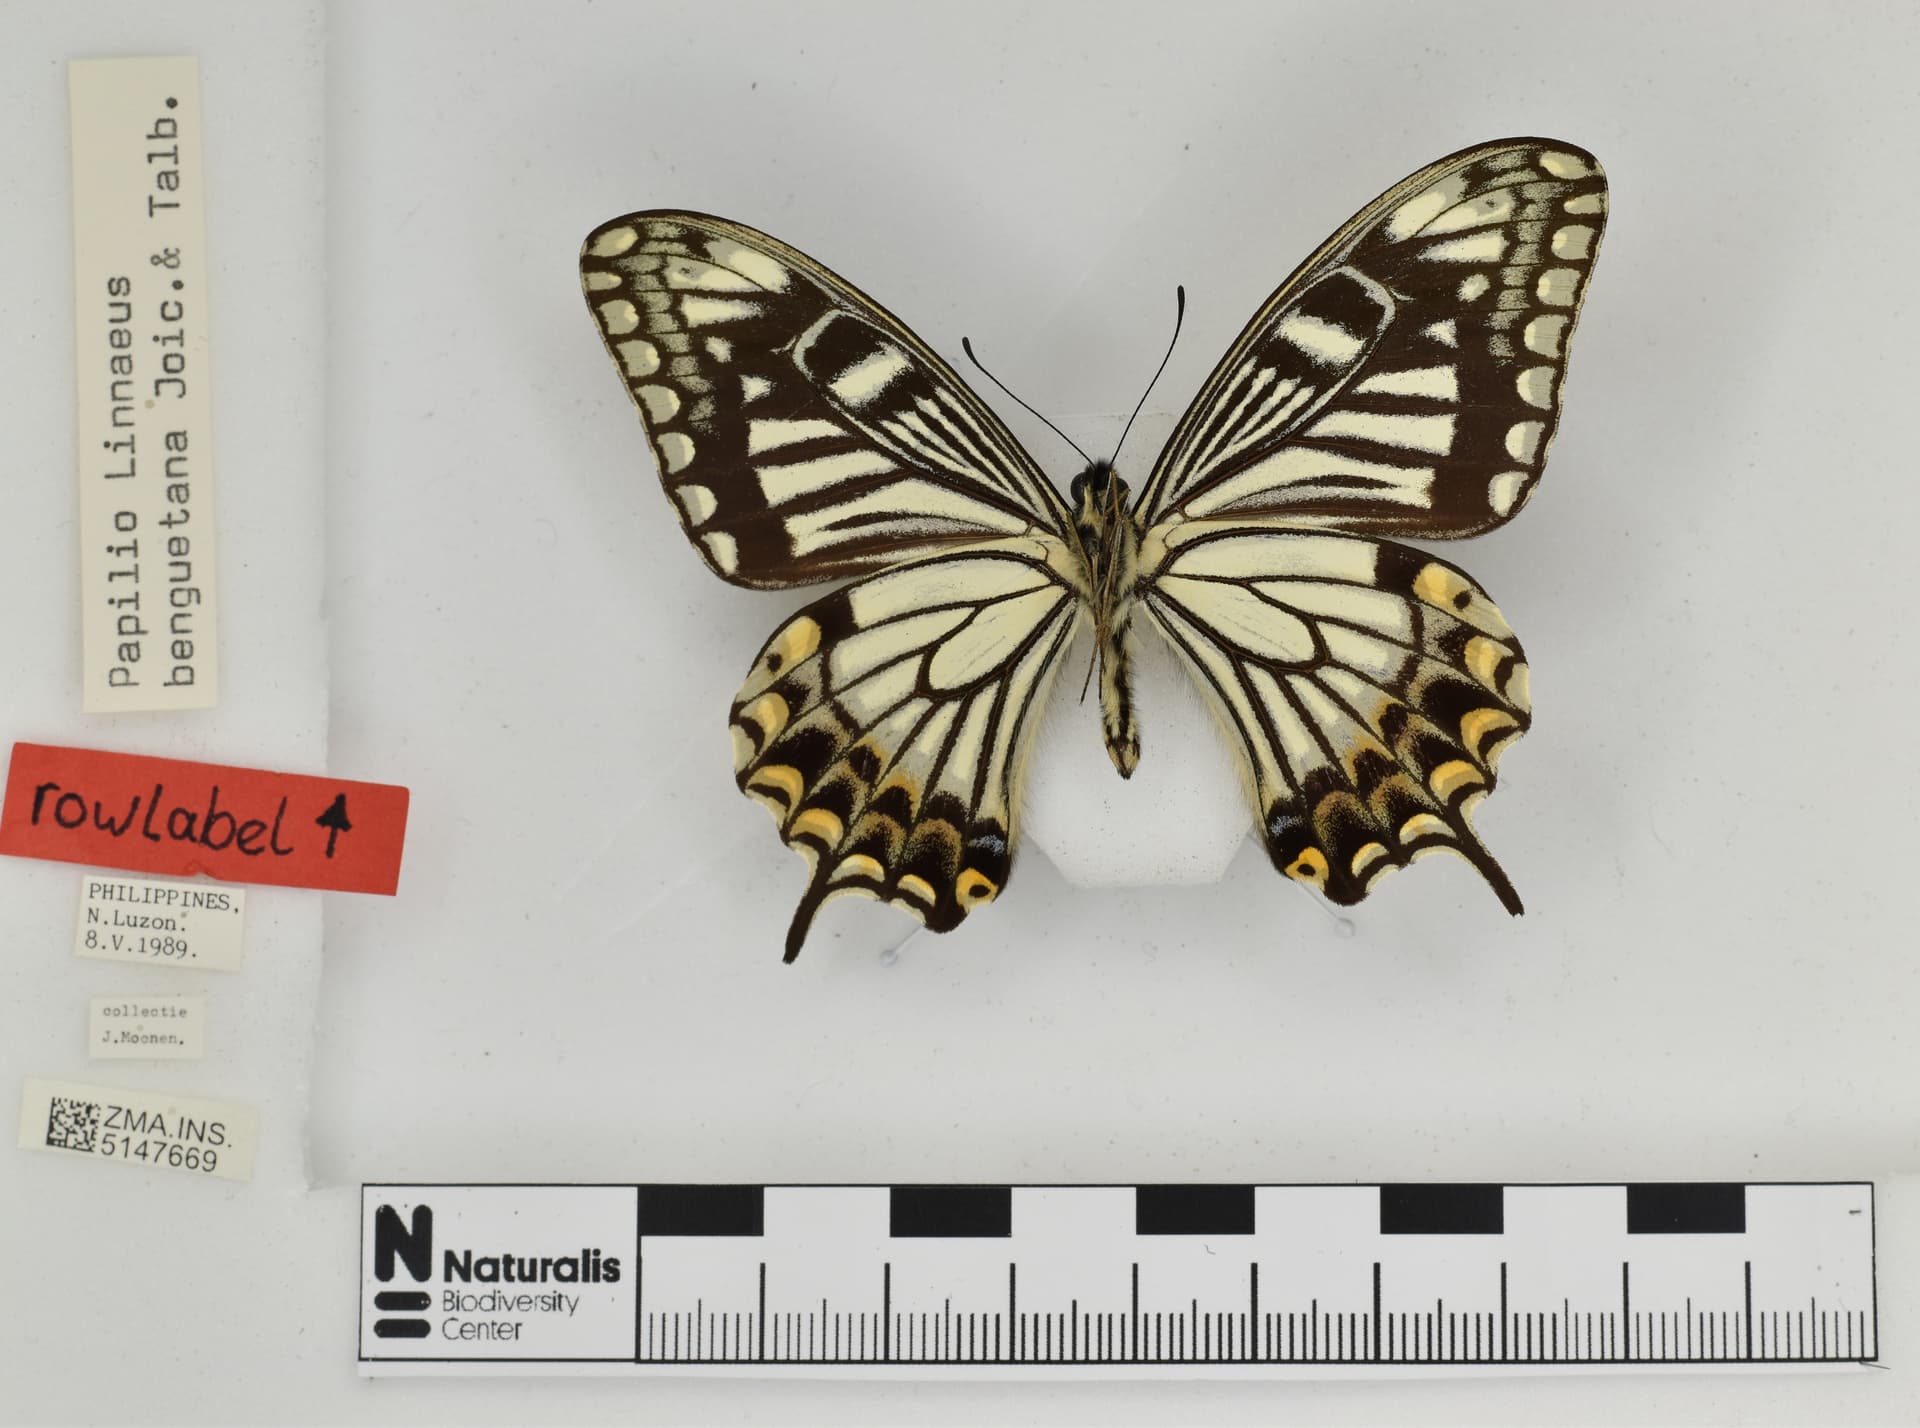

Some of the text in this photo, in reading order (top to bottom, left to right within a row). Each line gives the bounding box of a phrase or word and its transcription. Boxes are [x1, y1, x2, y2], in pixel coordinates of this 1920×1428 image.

[147, 96, 181, 218] Talb.
[103, 275, 149, 688] Papilio Linnaeus
[159, 428, 201, 688] benguetana
[31, 781, 294, 856] rowlabel
[87, 908, 188, 932] N.Luzon.
[84, 930, 198, 960] 8.V.1989.
[102, 1004, 189, 1019] collectie
[103, 1104, 233, 1148] ZMA.INS.
[100, 1132, 218, 1173] 5147669
[443, 1248, 621, 1283] Naturalis
[442, 1288, 580, 1317] Biodiversity
[441, 1317, 523, 1341] Center
